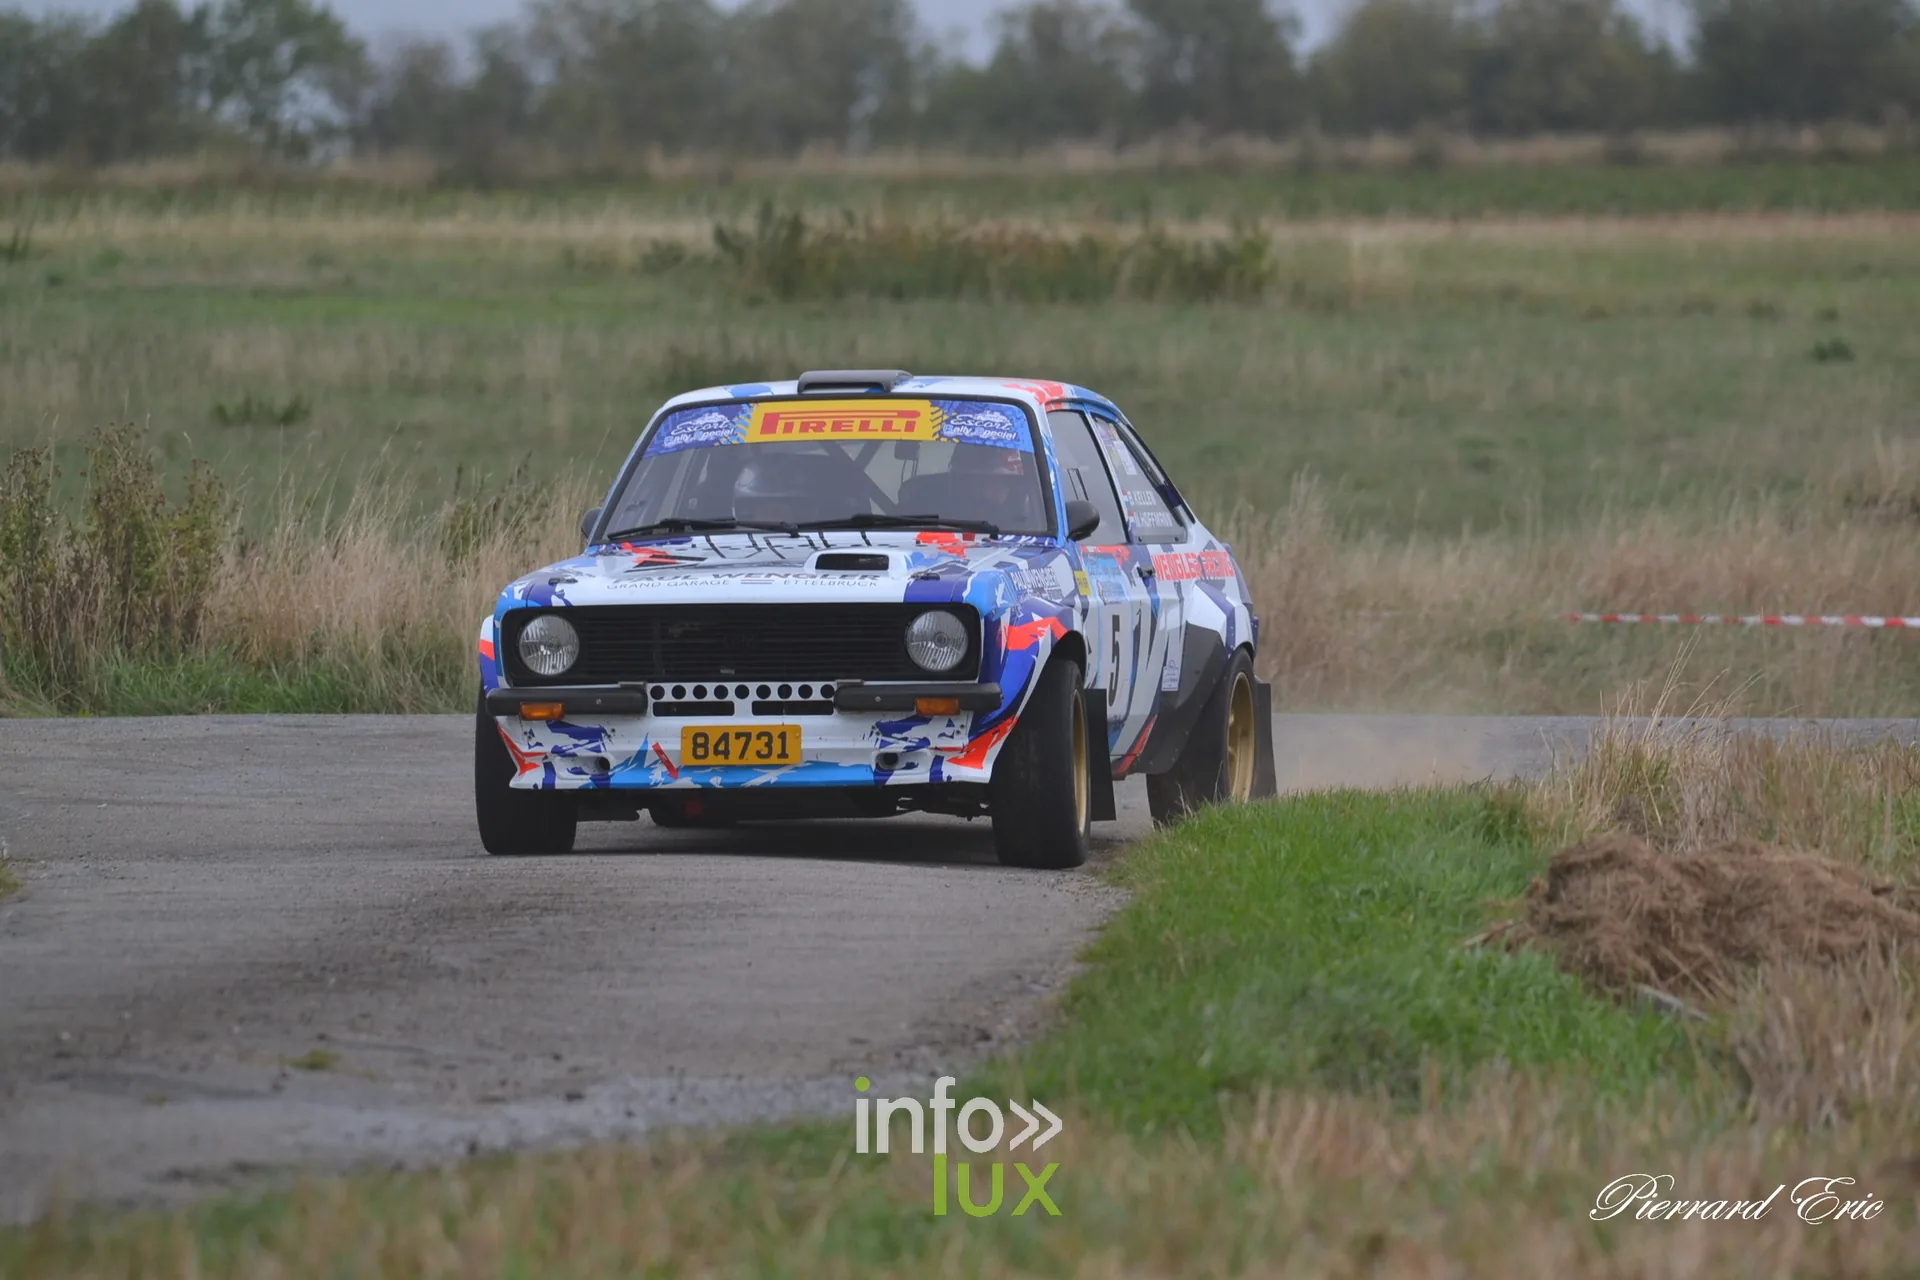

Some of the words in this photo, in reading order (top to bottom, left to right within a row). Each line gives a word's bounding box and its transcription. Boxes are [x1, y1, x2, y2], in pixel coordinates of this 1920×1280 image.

[671, 420, 729, 436] Escort
[760, 410, 921, 435] PIRELLI
[950, 414, 1013, 431] Escort
[606, 582, 662, 590] GRAND
[666, 579, 731, 587] GARAGE
[712, 572, 881, 581] WENGLER
[1108, 614, 1121, 707] 5
[691, 731, 790, 760] 84731
